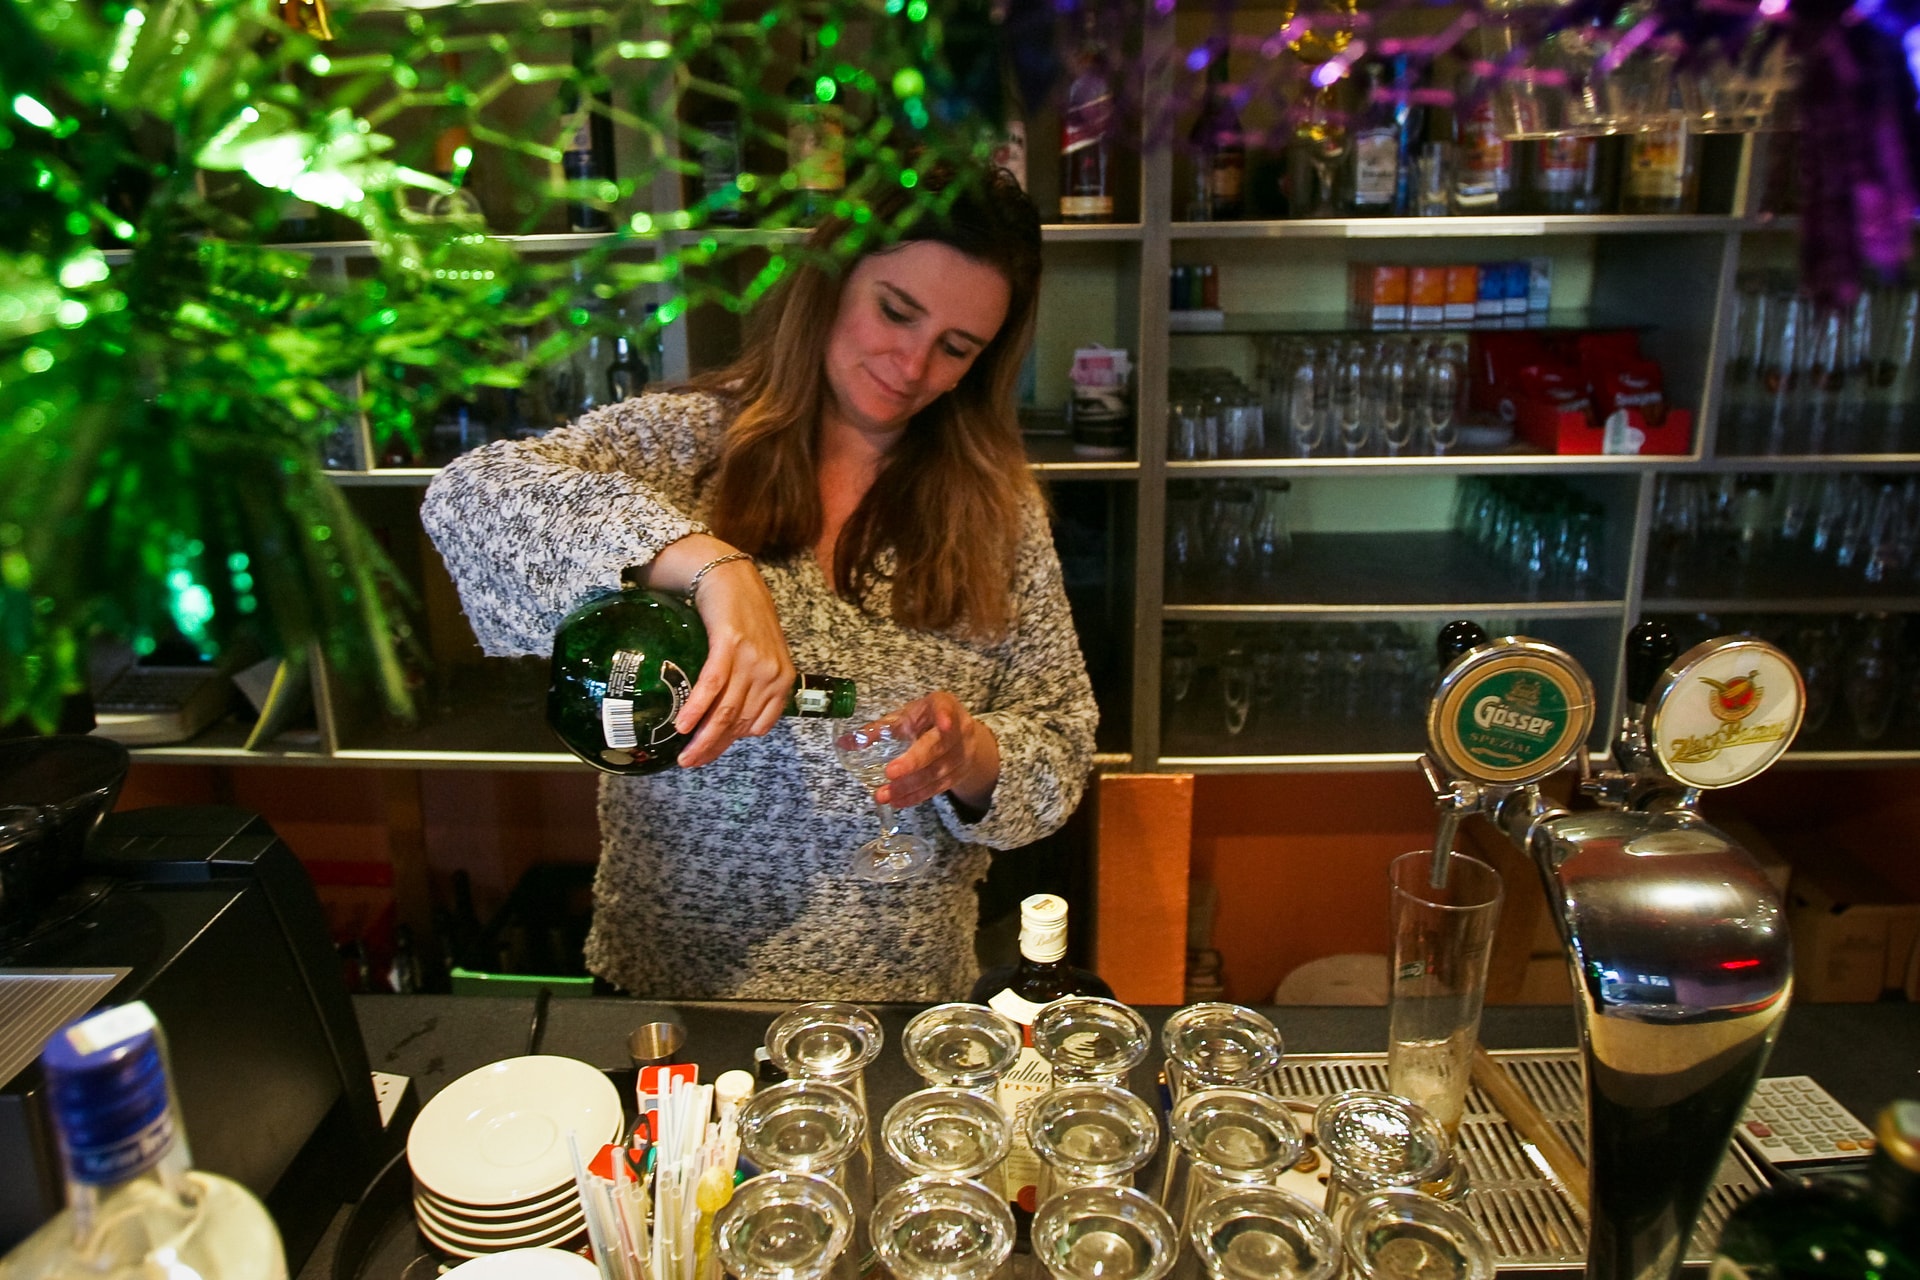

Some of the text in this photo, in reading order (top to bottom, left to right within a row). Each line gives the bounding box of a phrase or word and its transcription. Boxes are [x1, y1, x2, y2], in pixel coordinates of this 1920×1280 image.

[1474, 695, 1554, 737] Gösser
[1470, 733, 1533, 754] SPEZIAL
[1000, 1061, 1050, 1084] allan
